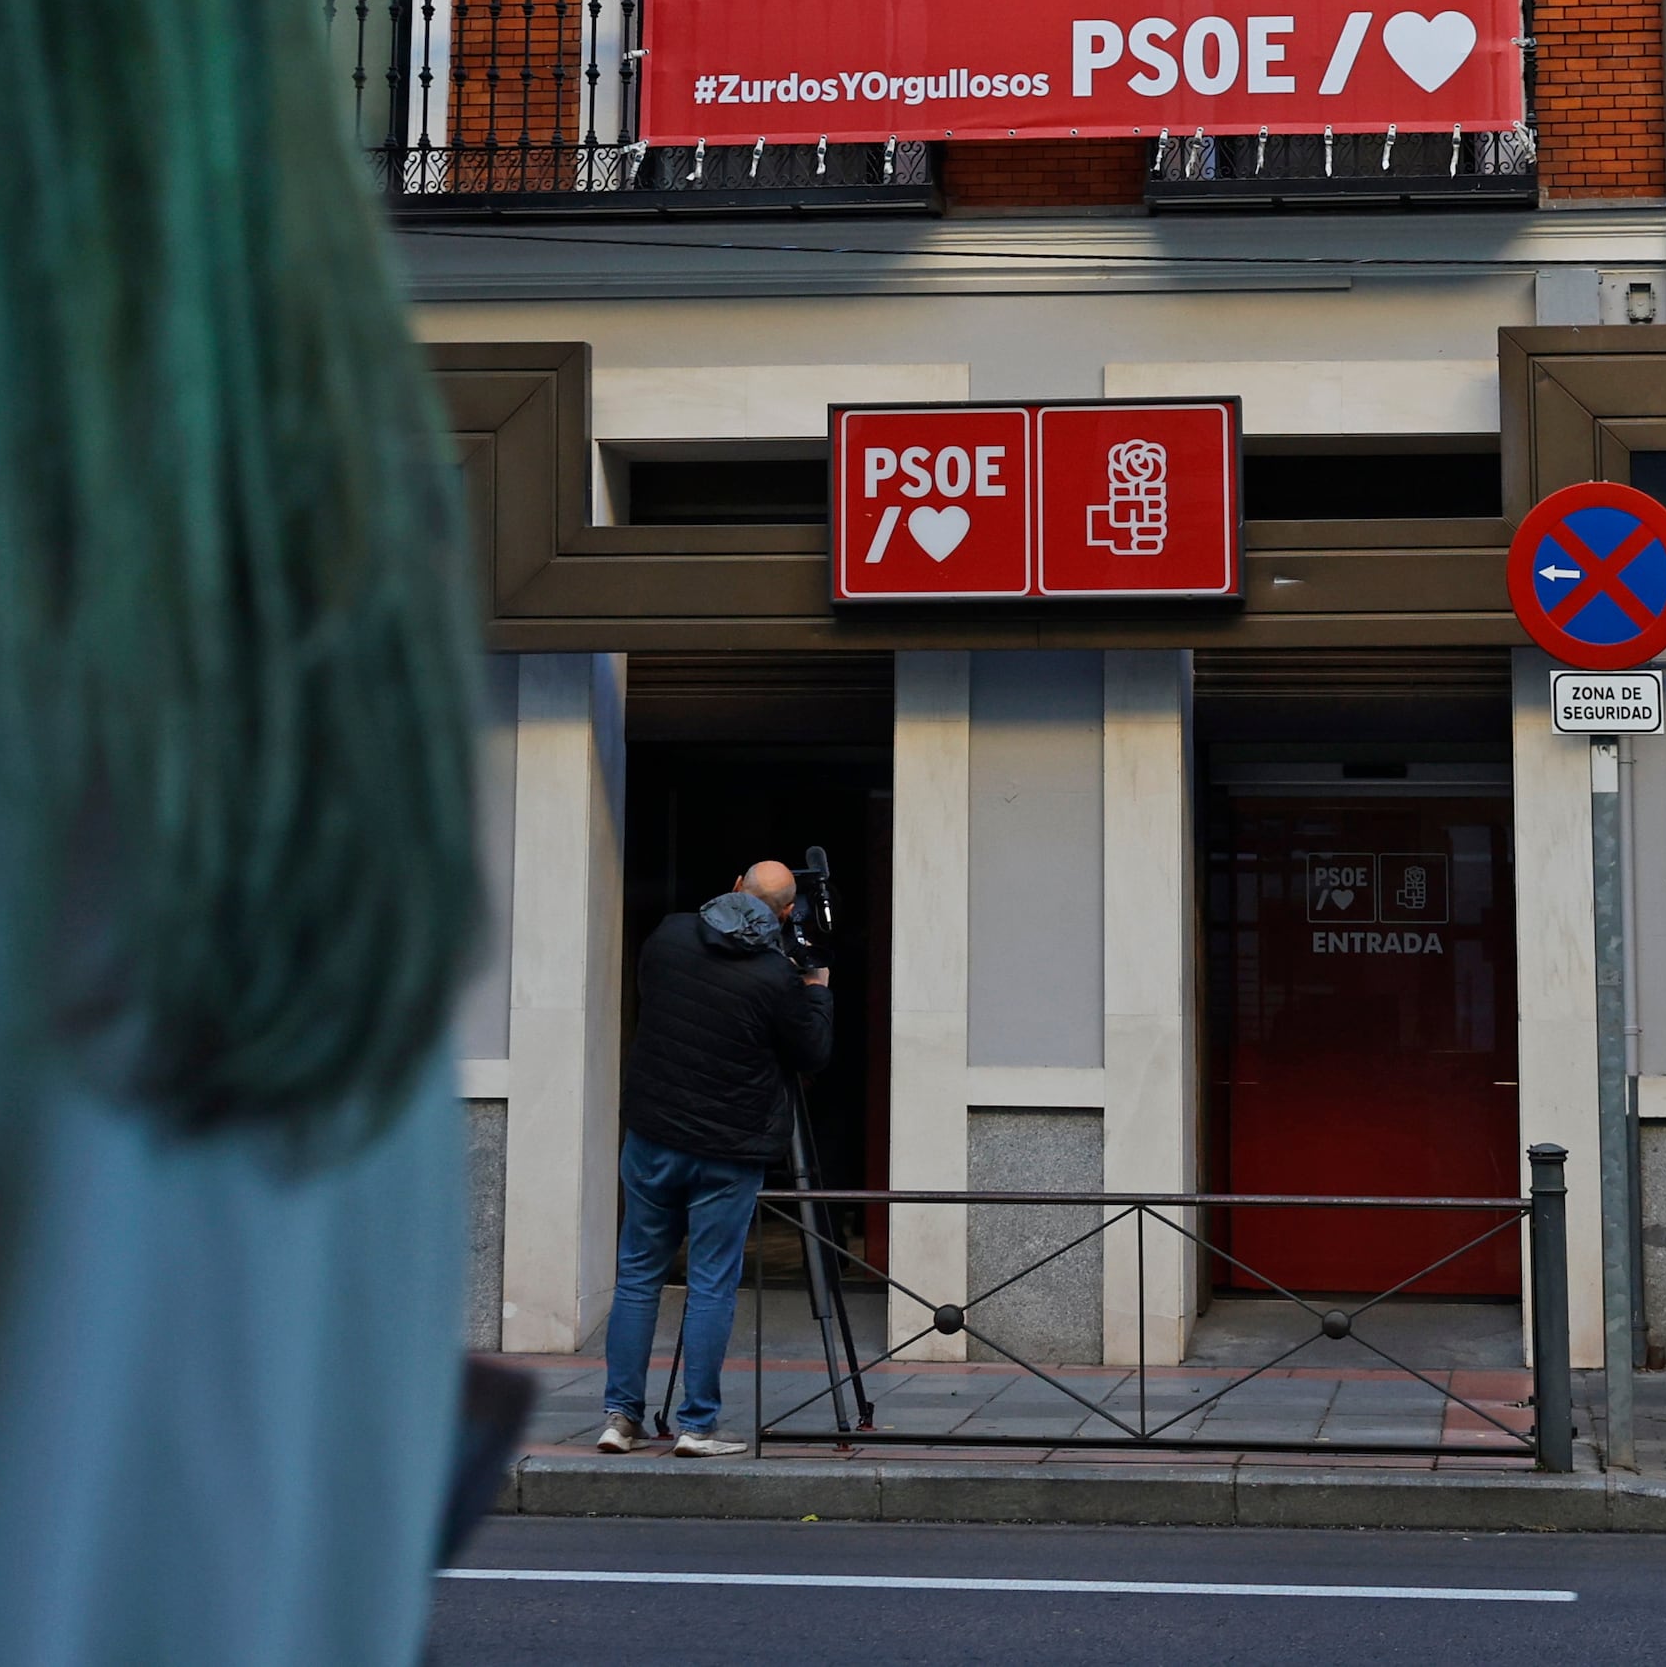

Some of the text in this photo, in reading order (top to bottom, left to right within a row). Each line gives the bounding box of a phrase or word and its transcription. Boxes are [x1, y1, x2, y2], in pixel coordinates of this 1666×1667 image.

[694, 68, 1051, 106] #ZurdosYOrgullosos
[1071, 15, 1297, 98] PSOE
[864, 445, 1008, 499] PSOE
[1572, 687, 1643, 701] ZONA DE
[1563, 706, 1653, 720] SEGURIDAD
[1314, 867, 1368, 887] PSOE
[1312, 931, 1444, 955] ENTRADA
